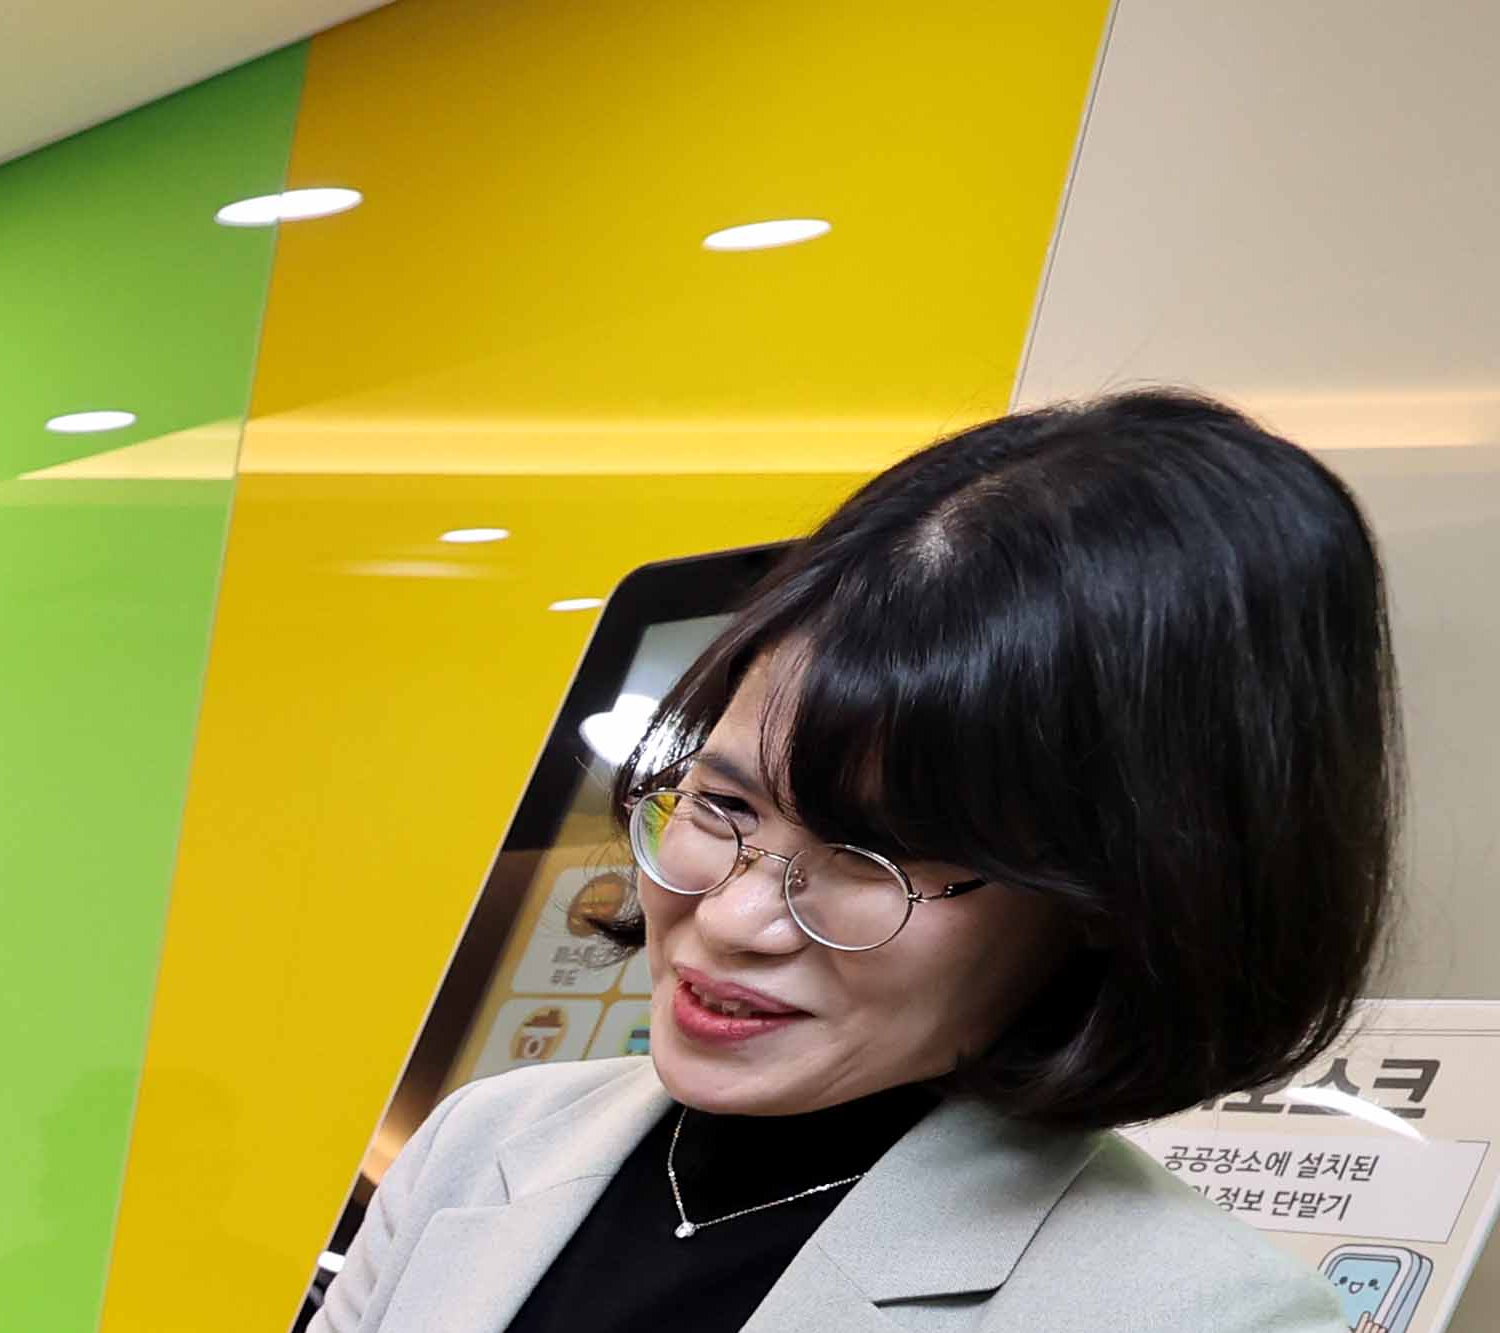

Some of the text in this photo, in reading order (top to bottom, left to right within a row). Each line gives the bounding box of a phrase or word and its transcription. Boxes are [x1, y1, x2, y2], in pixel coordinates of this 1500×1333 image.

[1200, 1057, 1441, 1119] 스크
[1163, 1145, 1380, 1183] 공공장소에 설치된
[1214, 1186, 1266, 1213] 정보
[1271, 1189, 1352, 1221] 단말기
